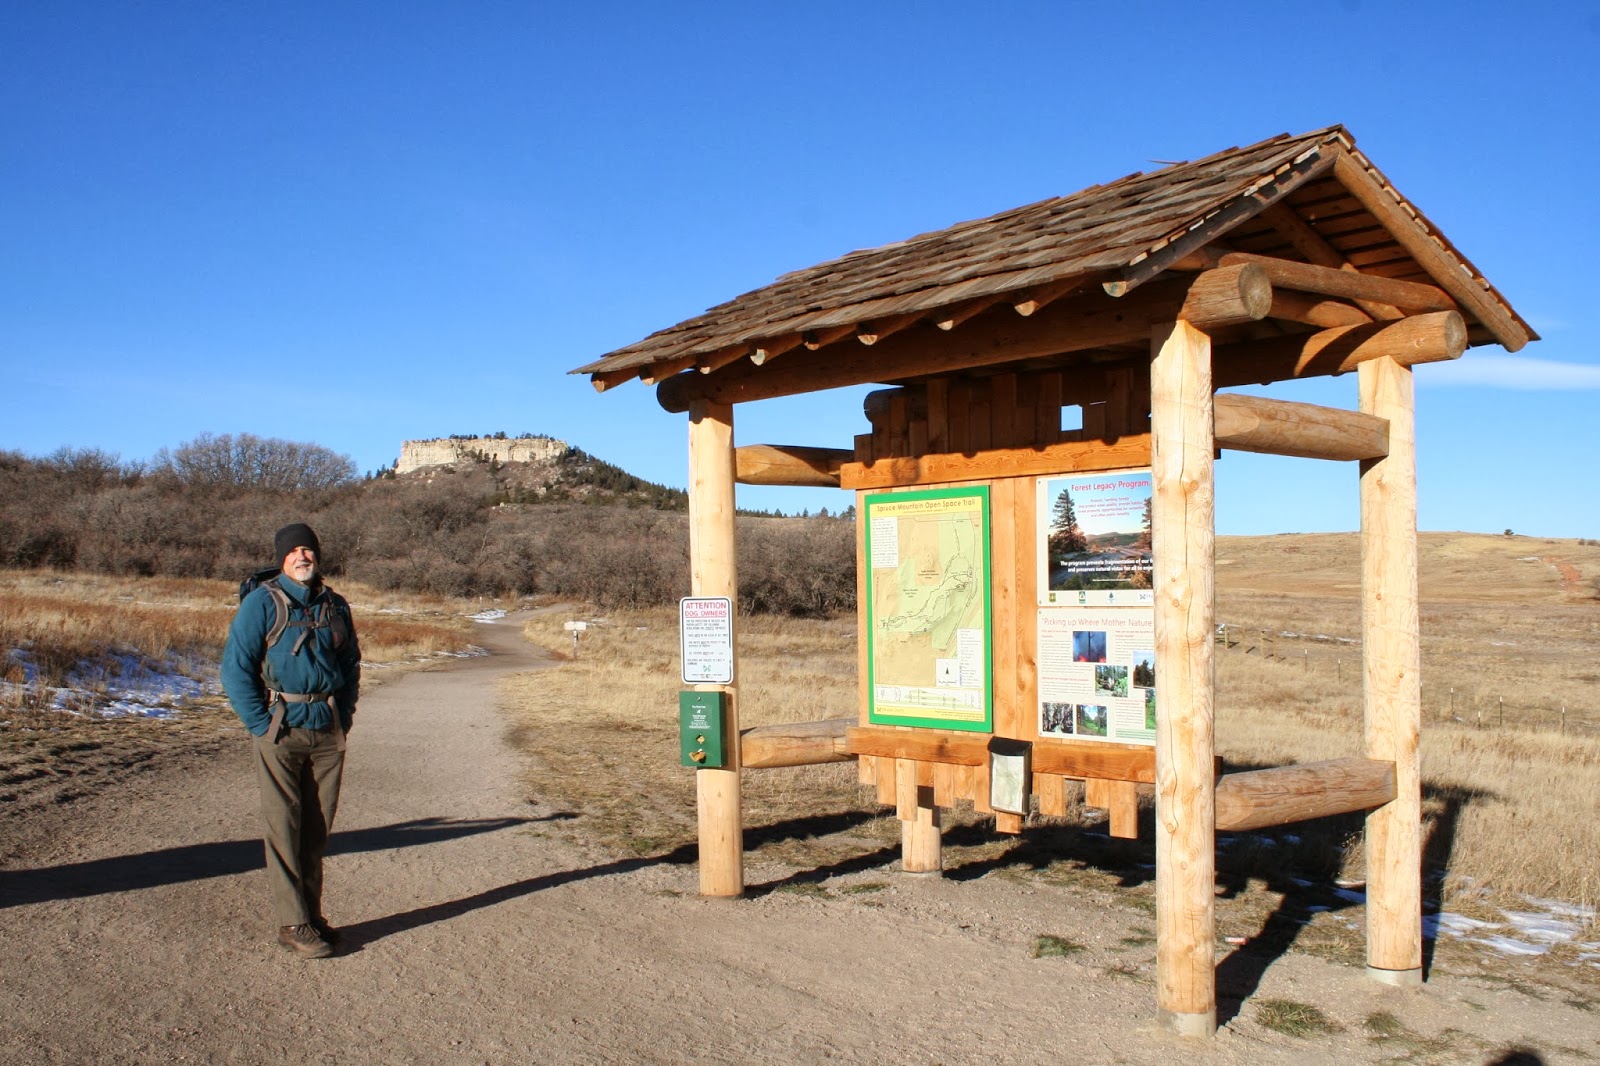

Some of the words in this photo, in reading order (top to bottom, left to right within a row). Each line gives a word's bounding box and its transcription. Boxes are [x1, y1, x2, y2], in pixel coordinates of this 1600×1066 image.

[1094, 482, 1116, 491] Legacy
[1118, 480, 1150, 489] Program.
[898, 502, 924, 510] Mountain
[942, 500, 961, 509] Space
[1101, 618, 1126, 626] Mother
[1128, 619, 1152, 627] Nature
